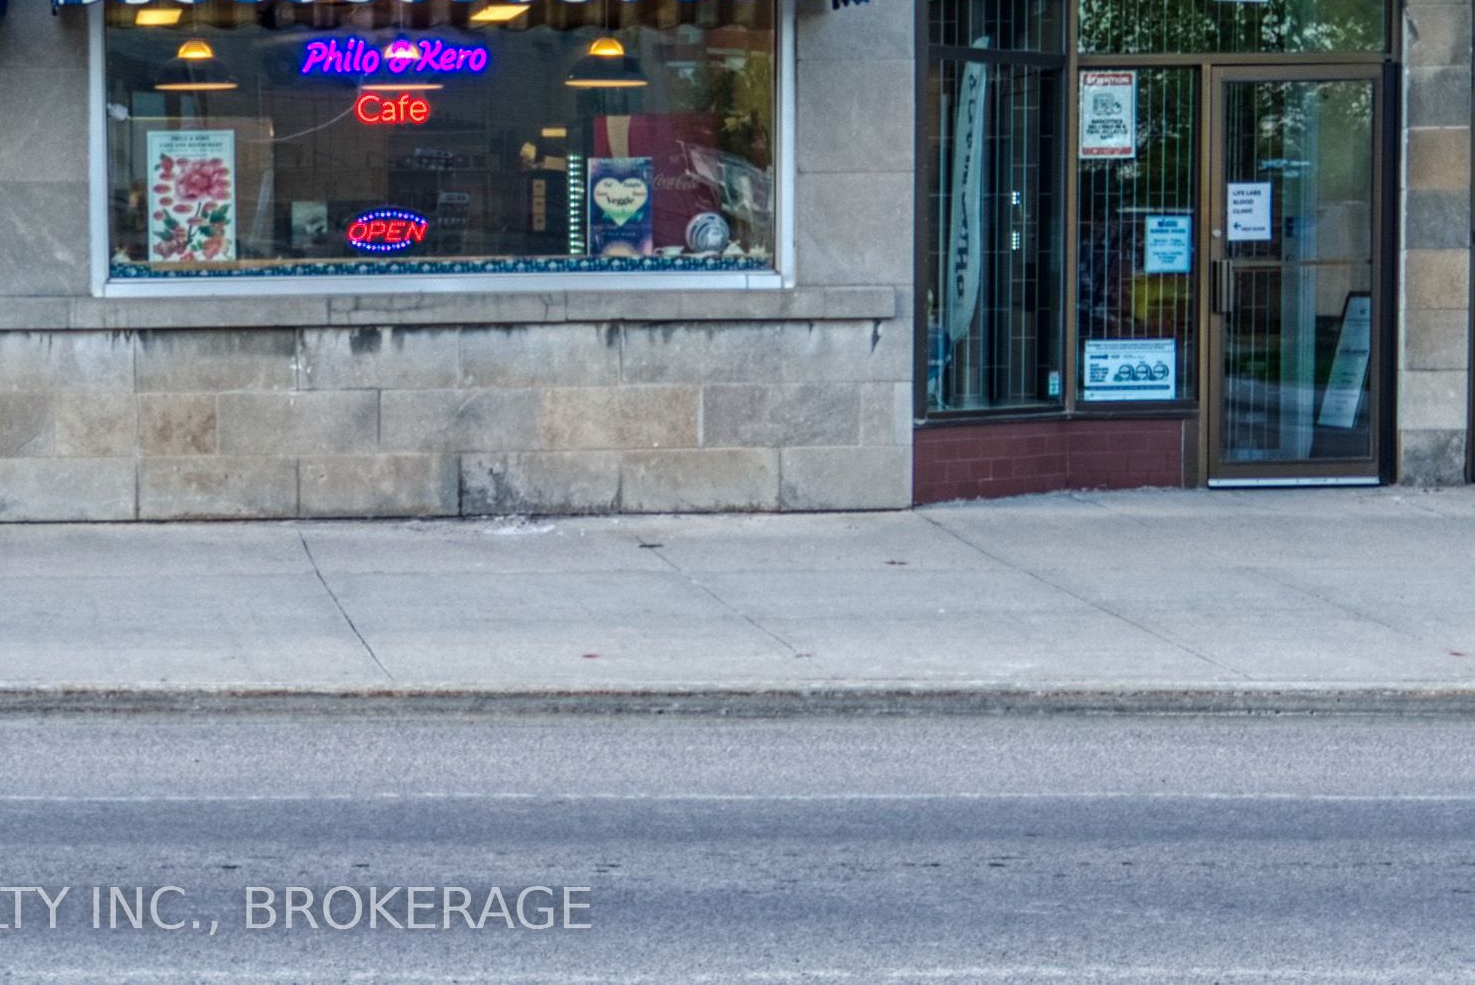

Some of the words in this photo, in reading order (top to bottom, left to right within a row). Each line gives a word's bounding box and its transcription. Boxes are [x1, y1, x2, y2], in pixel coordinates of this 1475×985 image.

[302, 38, 380, 74] Philo
[416, 40, 487, 72] Kero
[355, 93, 430, 123] Cafe
[606, 197, 635, 206] Veggie
[347, 220, 429, 244] OPEN
